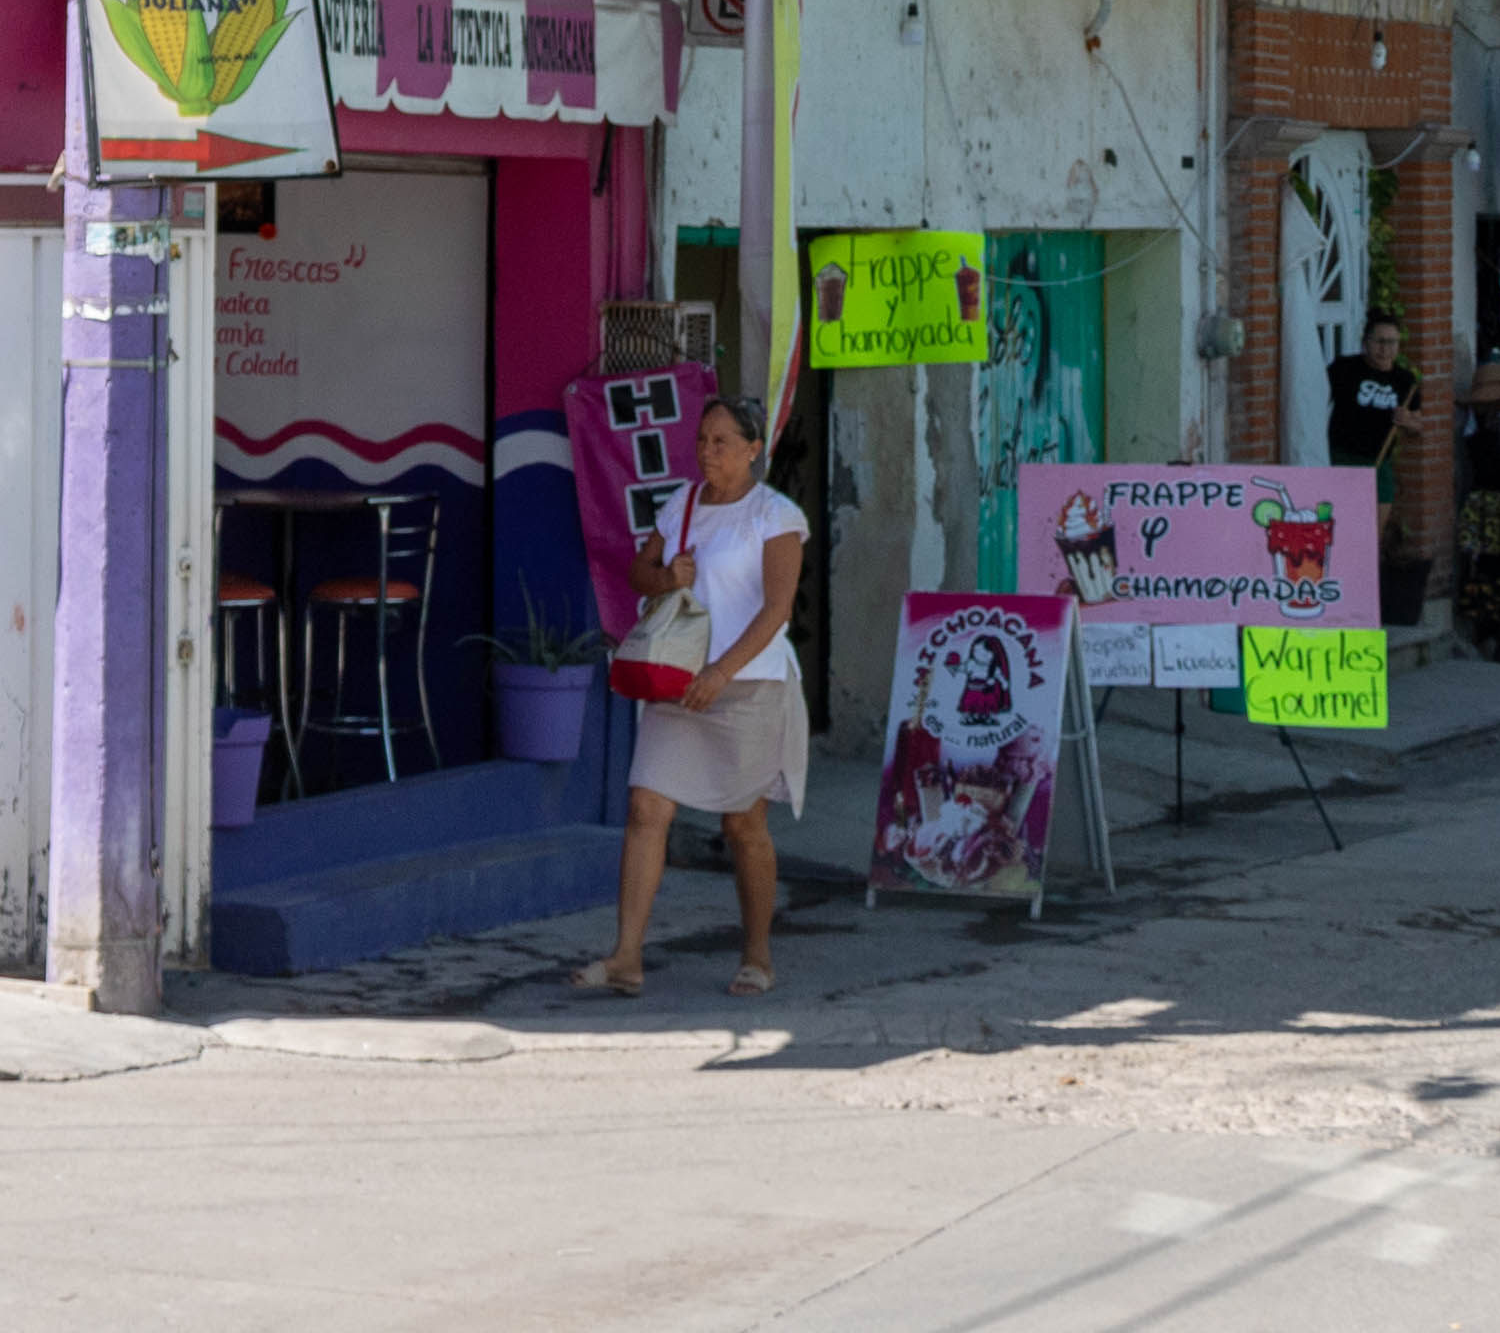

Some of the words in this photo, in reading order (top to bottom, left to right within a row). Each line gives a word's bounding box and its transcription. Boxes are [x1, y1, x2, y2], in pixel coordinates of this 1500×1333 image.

[417, 5, 434, 64] LA
[443, 7, 513, 68] AUTENTICA
[521, 15, 596, 75] MICHOACANA
[225, 351, 299, 376] Colada
[1107, 481, 1244, 509] FRAPPE
[1111, 575, 1343, 608] CHAMOYADAS
[912, 609, 1045, 690] MICHOACANA
[1247, 629, 1385, 682] Waffles
[1246, 676, 1381, 721] Gourmet
[966, 712, 1029, 749] natural
